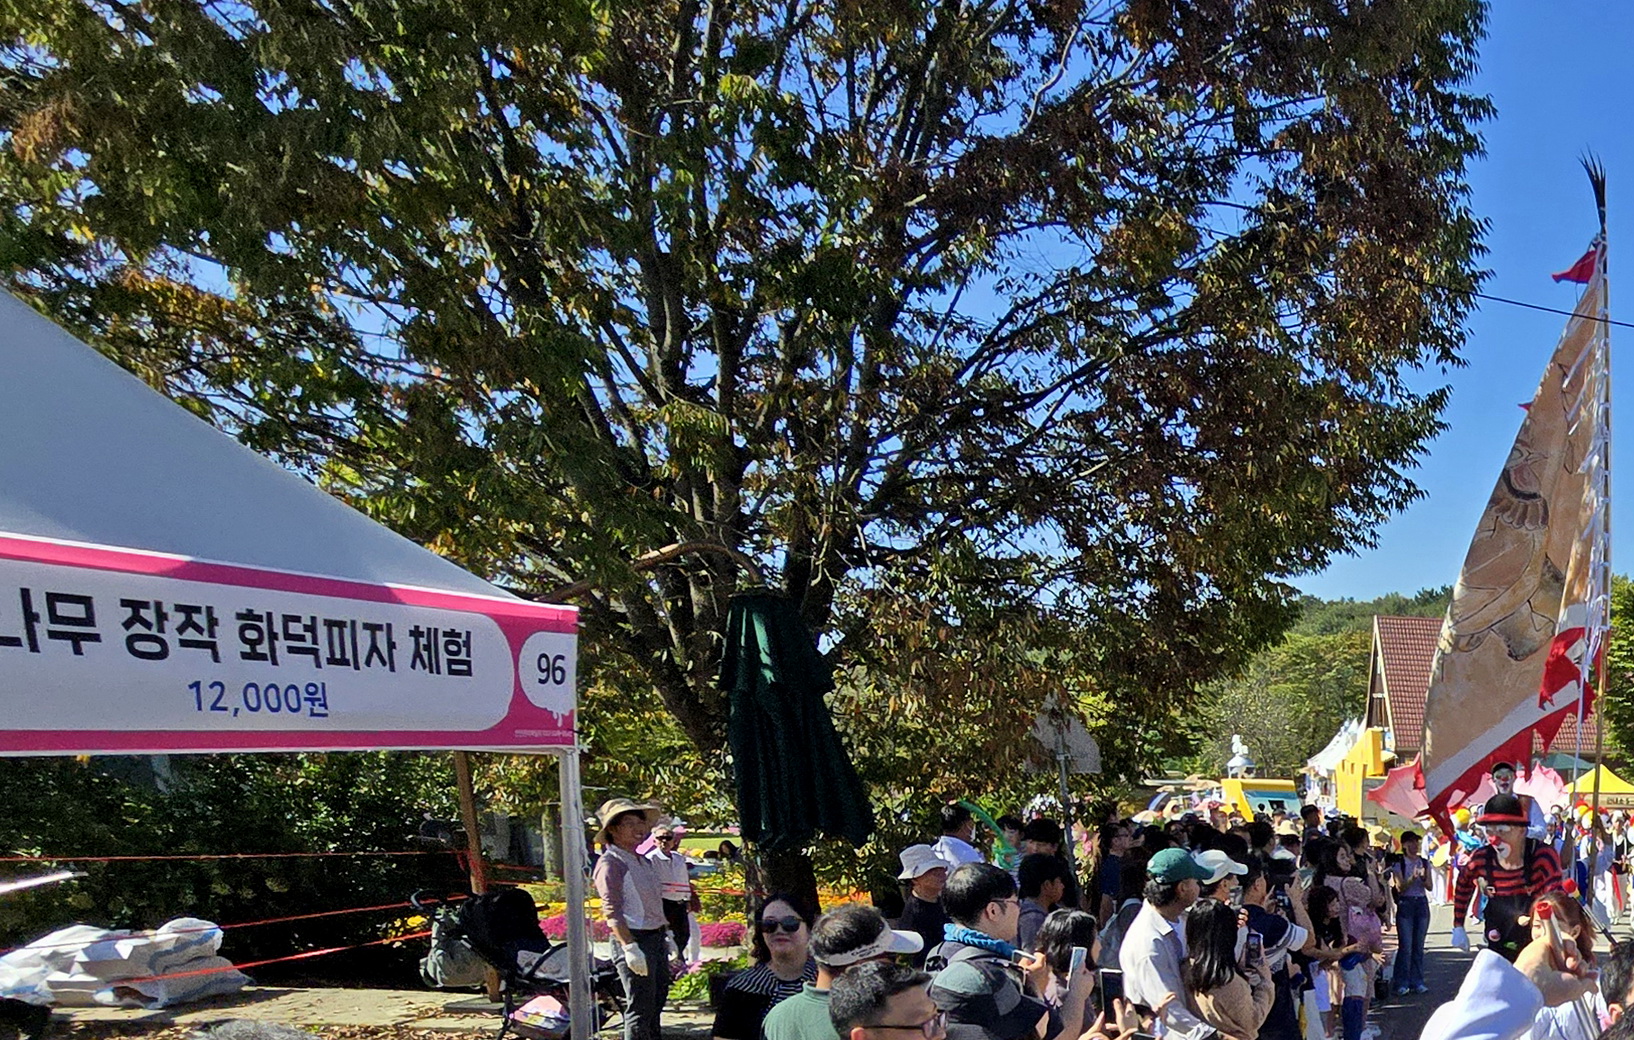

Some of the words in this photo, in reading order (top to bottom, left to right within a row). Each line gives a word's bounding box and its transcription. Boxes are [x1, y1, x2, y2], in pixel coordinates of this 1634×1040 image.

[119, 598, 222, 663] 장작
[235, 608, 397, 673] 화덕피자
[408, 625, 474, 677] 체험
[536, 652, 566, 685] 96
[187, 679, 329, 717] 12,000원
